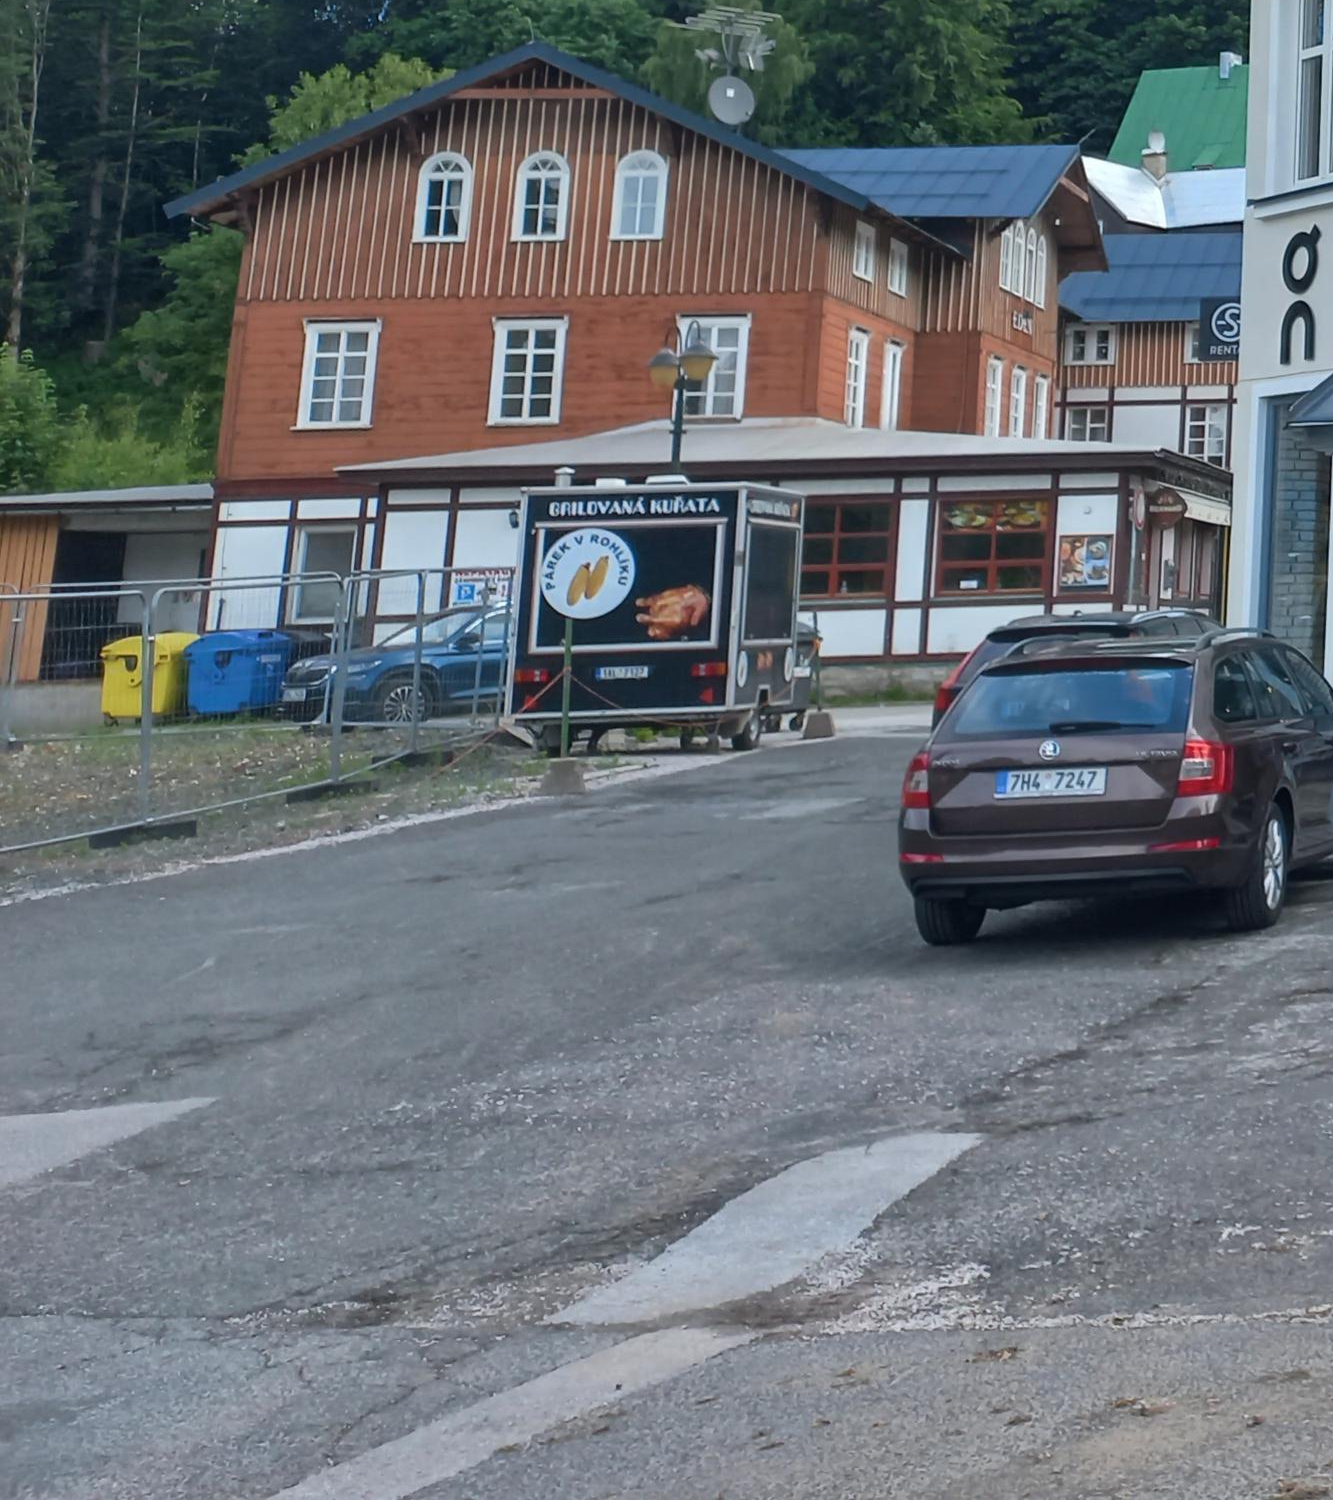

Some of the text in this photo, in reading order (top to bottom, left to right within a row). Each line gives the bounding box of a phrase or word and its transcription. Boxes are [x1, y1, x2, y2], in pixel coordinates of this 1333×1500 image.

[548, 495, 720, 518] GRILOVANÁ KUŘATA
[573, 534, 584, 546] V
[590, 533, 630, 587] ROHLÍKU
[1010, 770, 1097, 791] 7H4 7247
